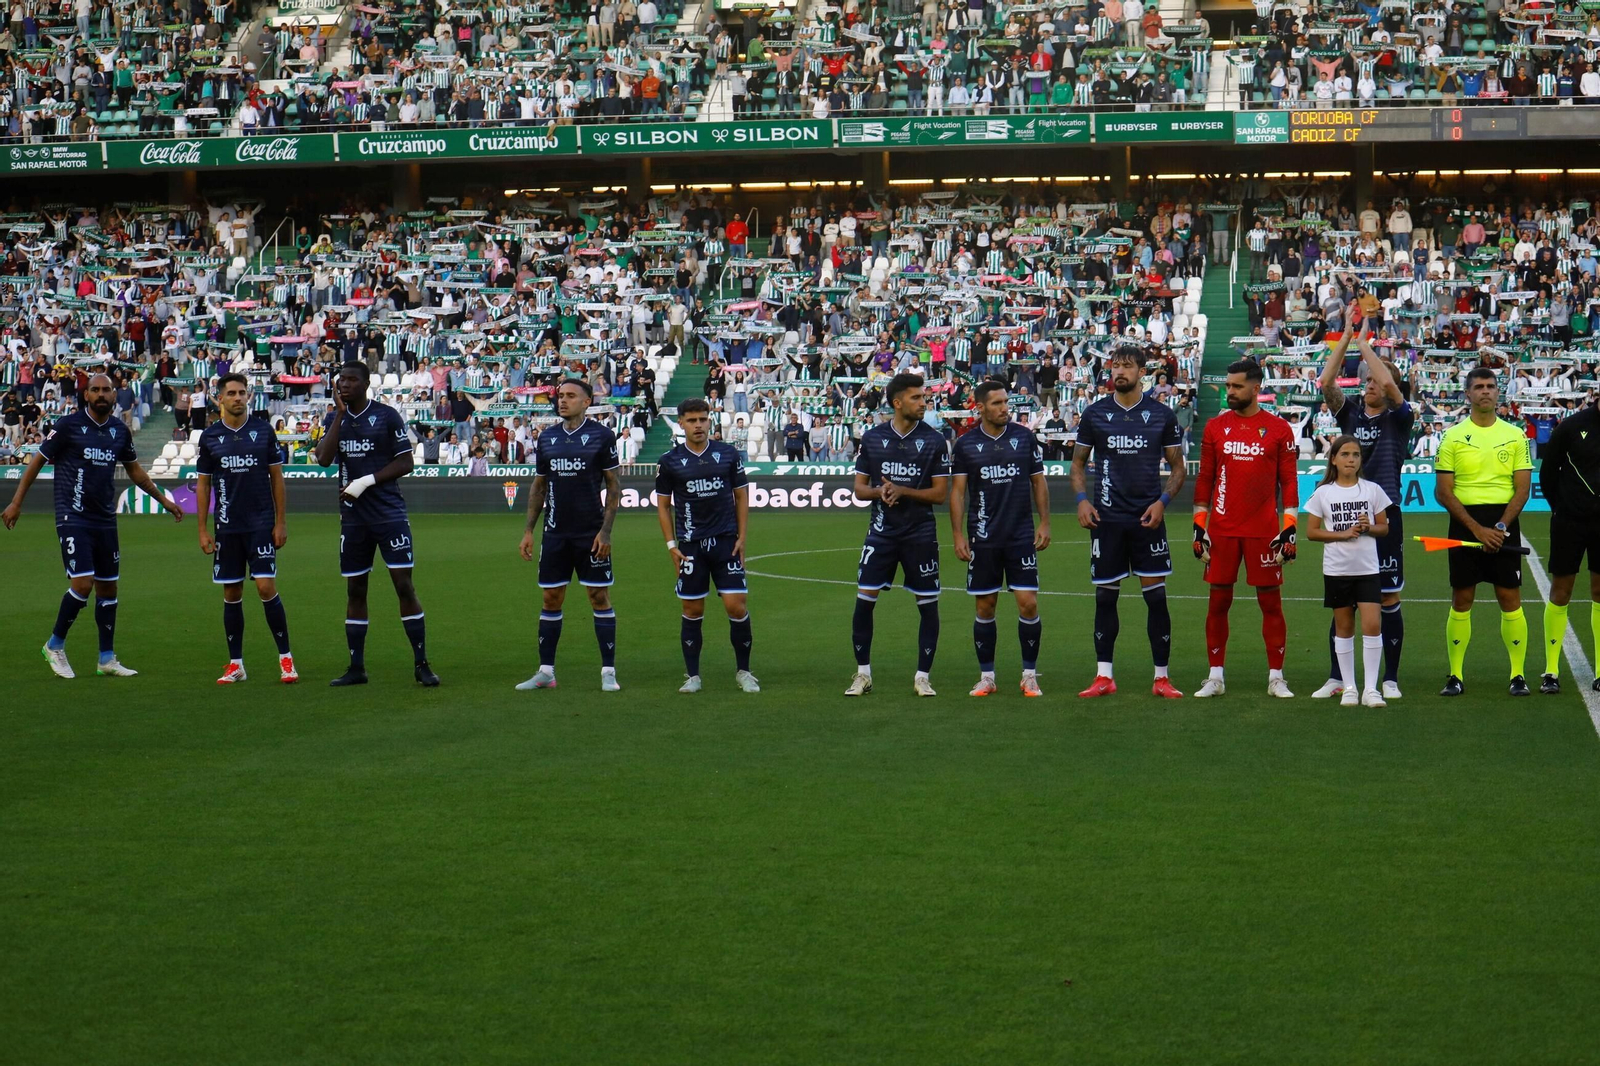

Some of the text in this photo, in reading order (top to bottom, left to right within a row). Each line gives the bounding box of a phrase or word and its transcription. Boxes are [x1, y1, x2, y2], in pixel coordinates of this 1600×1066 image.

[1292, 110, 1379, 125] CORDOBA CF
[1452, 109, 1462, 123] 0
[914, 121, 961, 130] Flight Vocation
[1039, 119, 1086, 128] Flight Vocation
[1113, 123, 1158, 131] URBYSER
[1179, 122, 1224, 130] URBYSER
[614, 129, 698, 145] SILBON
[733, 126, 819, 142] SILBON
[1292, 128, 1362, 142] CADIZ CF
[1452, 126, 1462, 140] 0
[235, 136, 298, 162] Coca-Cola
[358, 137, 447, 155] Cruzcampo
[469, 133, 559, 151] Cruzcampo
[140, 137, 202, 164] Coca-Cola
[11, 159, 88, 170] SAN RAFAEL MOTOR
[448, 467, 529, 477] PATMONIO
[1330, 500, 1369, 513] UN EQUIPO
[1332, 513, 1342, 523] NO
[1343, 511, 1361, 522] DEJ
[66, 536, 76, 555] 3
